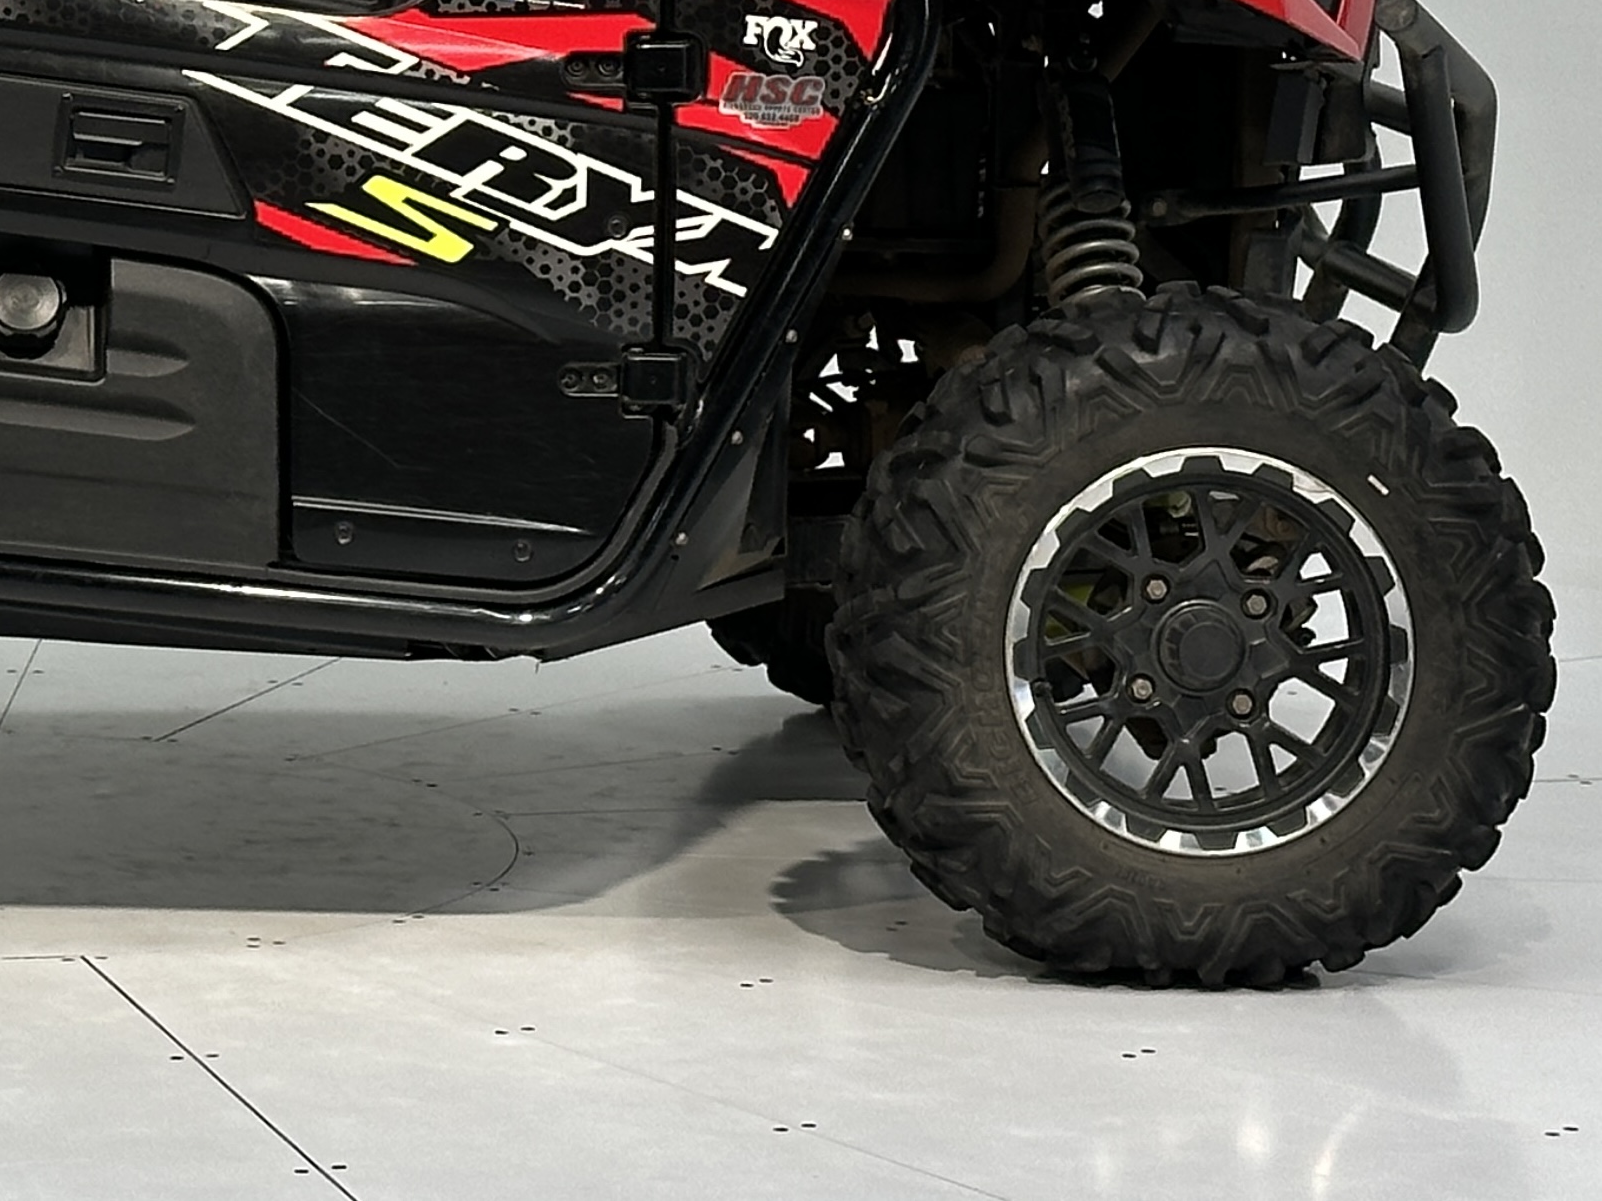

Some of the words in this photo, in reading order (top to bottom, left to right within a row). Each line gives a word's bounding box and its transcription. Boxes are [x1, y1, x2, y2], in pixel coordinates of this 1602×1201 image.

[743, 14, 818, 68] FOX
[722, 73, 824, 105] HSC
[305, 174, 499, 264] S
